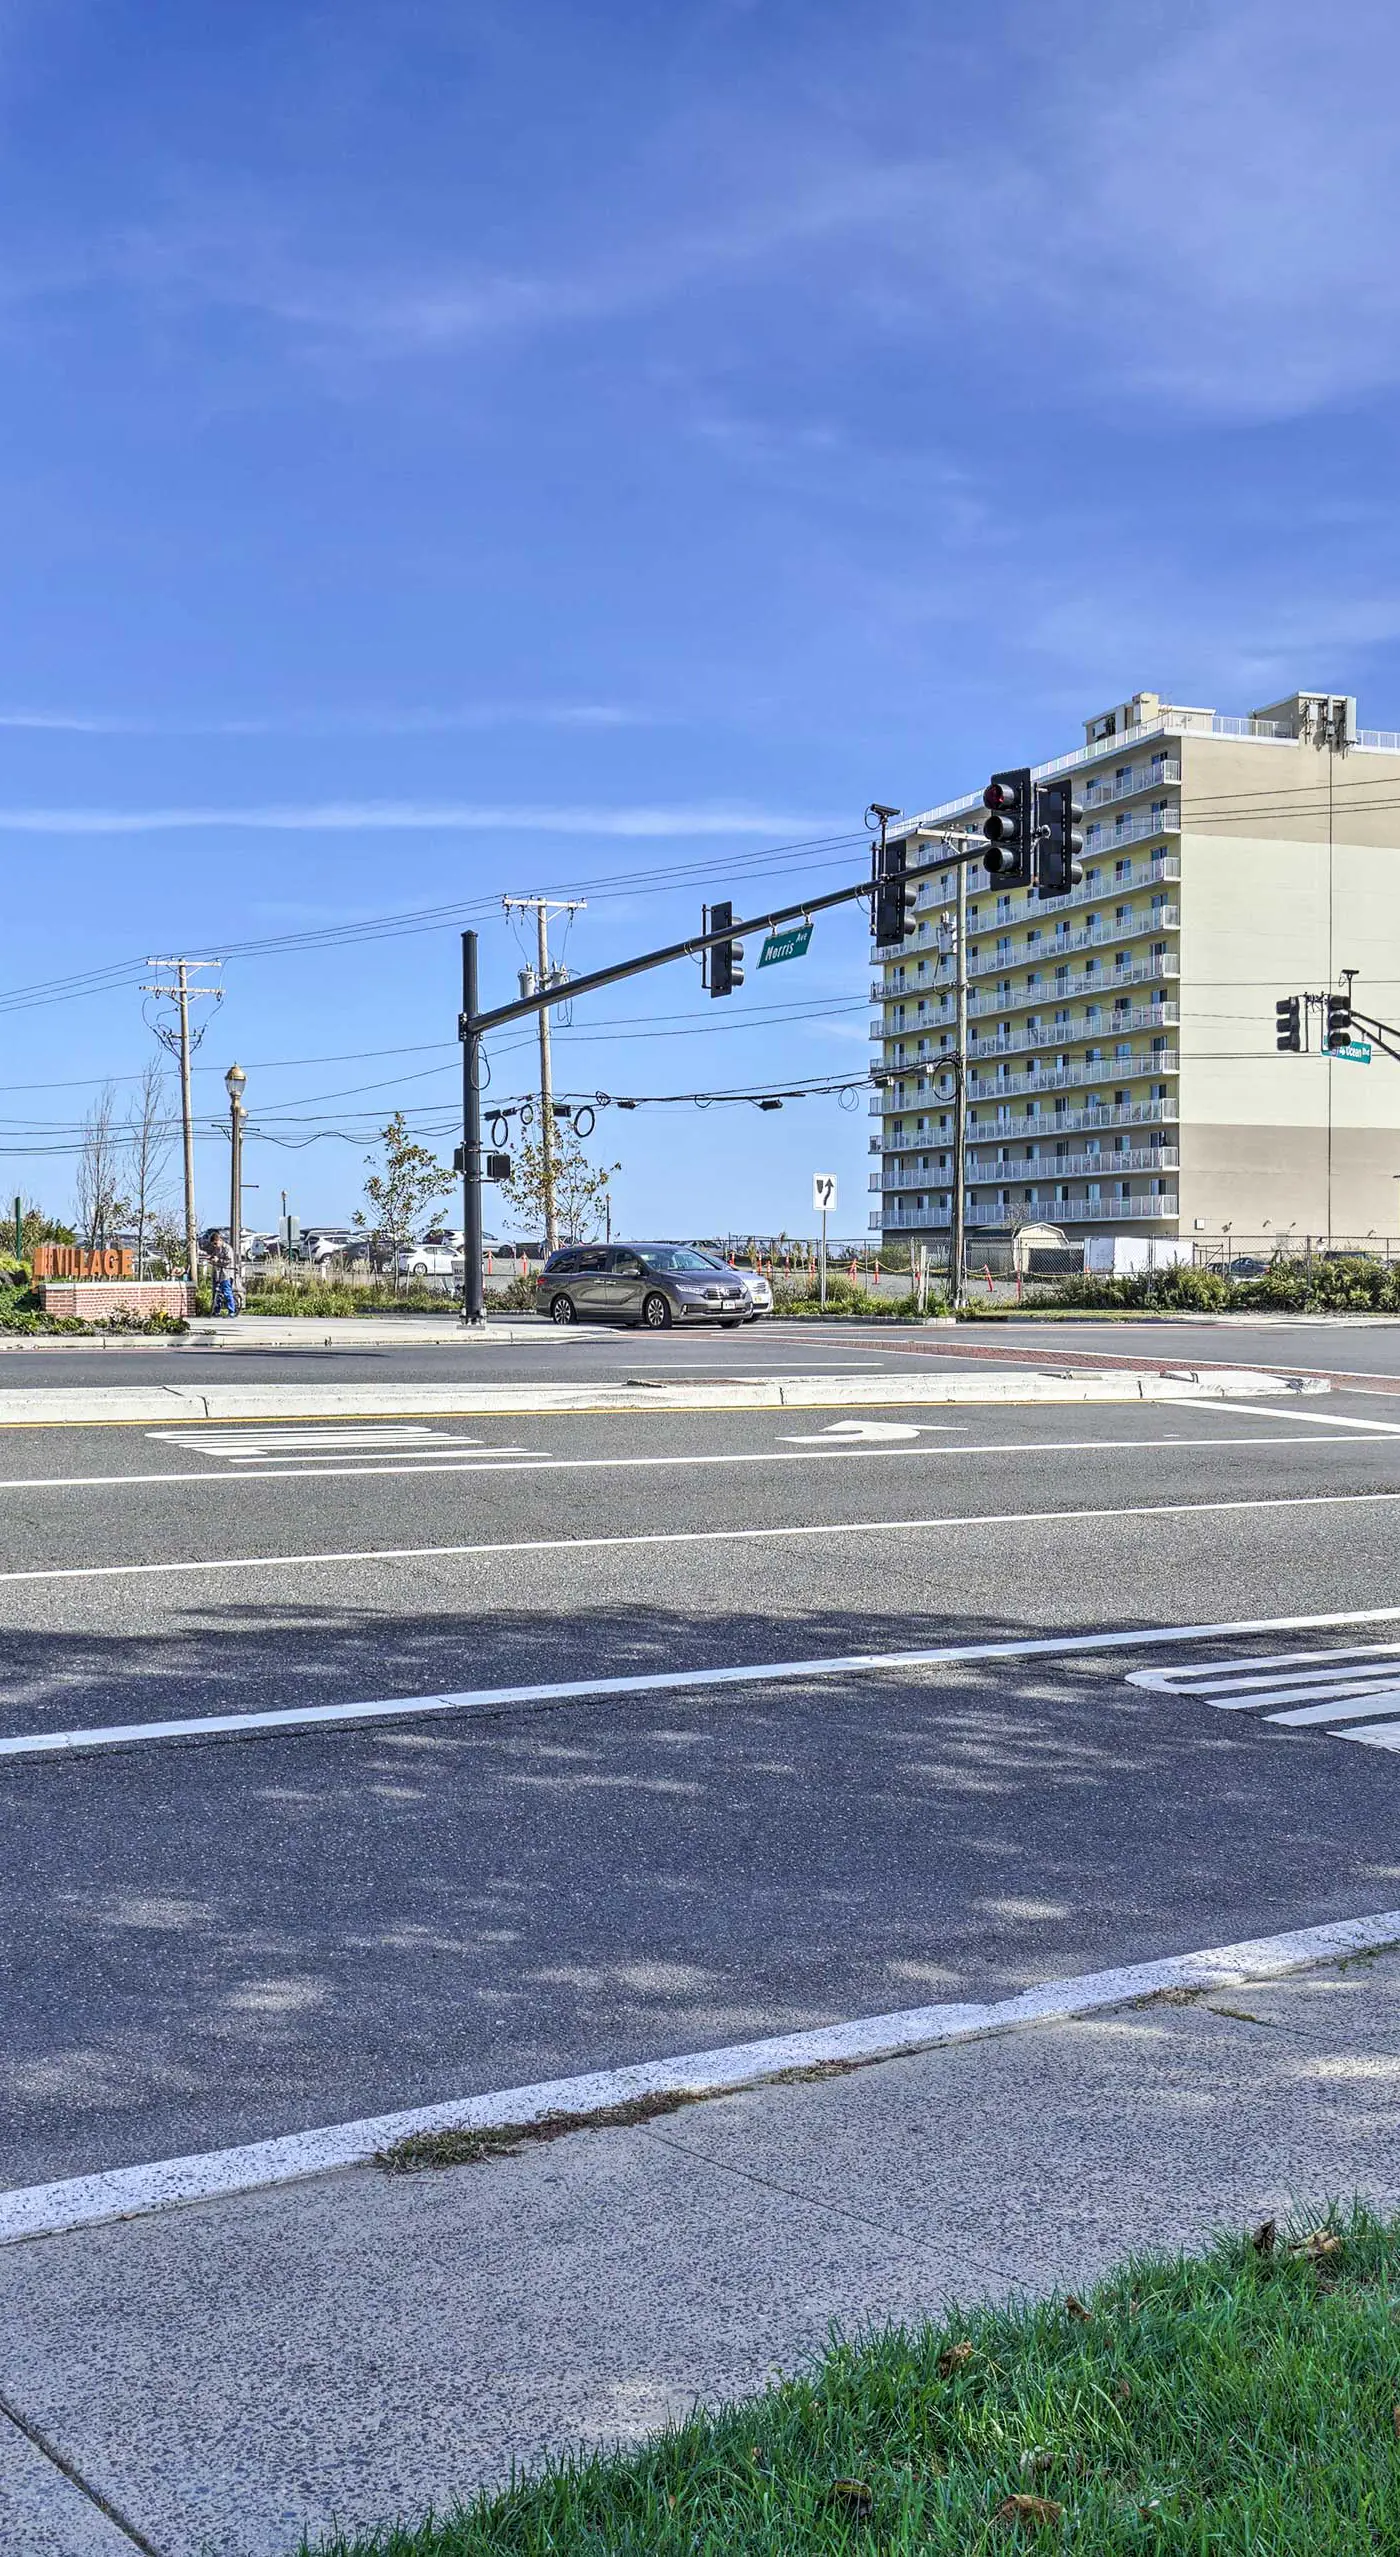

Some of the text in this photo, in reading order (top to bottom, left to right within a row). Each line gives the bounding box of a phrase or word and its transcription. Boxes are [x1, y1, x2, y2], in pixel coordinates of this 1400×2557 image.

[765, 932, 808, 961] Morris Ave
[1346, 1046, 1362, 1058] Ocean
[56, 1248, 134, 1276] VILLAGE
